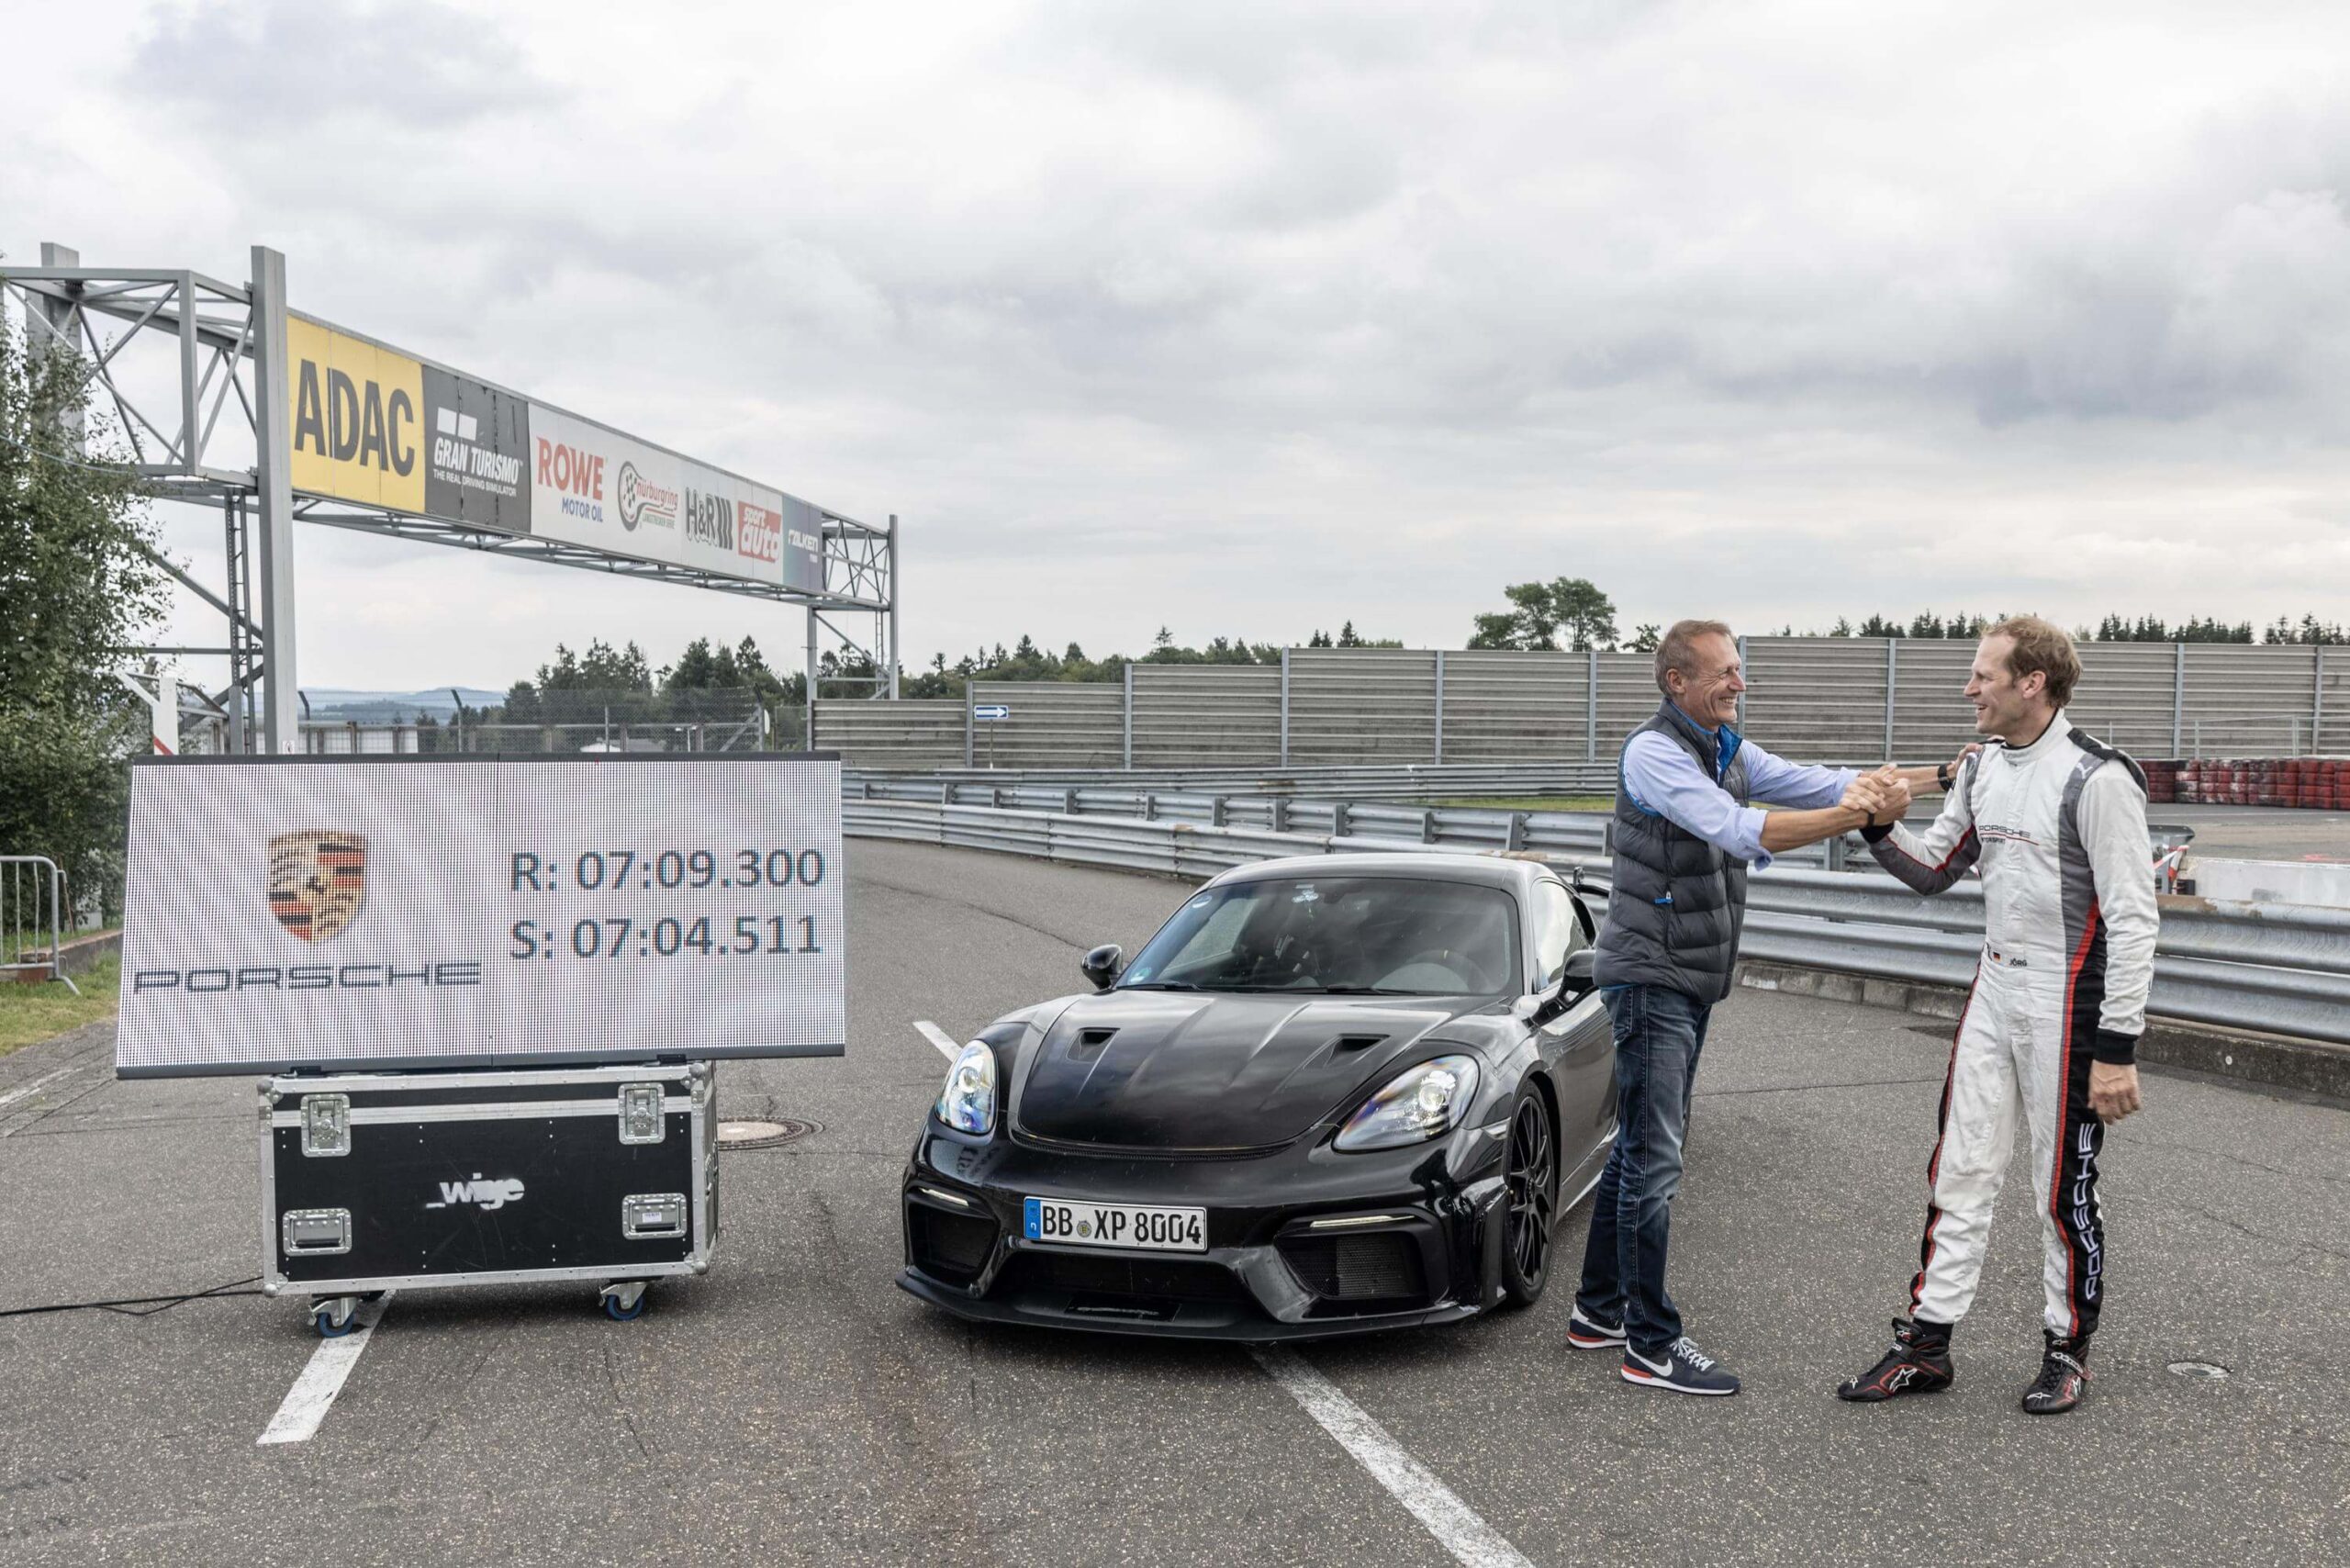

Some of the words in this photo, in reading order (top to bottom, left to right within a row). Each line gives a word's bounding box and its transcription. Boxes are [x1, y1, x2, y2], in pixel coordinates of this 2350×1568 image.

[295, 359, 415, 477] ADAC
[434, 437, 468, 472] GRAN
[471, 447, 519, 485] TURISMO
[537, 436, 603, 500] ROWE
[433, 468, 445, 480] THE
[446, 472, 461, 485] REAL
[463, 476, 485, 490] DRIVING
[486, 481, 517, 497] SIMULATOR
[562, 498, 590, 520] MOTOR
[591, 506, 603, 522] OIL
[686, 487, 716, 545] H&R
[744, 507, 766, 528] sport
[741, 525, 781, 560] auto
[1979, 824, 2031, 839] PORSCHE
[511, 852, 558, 891] R:
[576, 848, 825, 890] 07:09.300
[509, 922, 554, 960] S:
[571, 914, 822, 958] 07:04.511
[134, 961, 482, 994] PORSCHE
[2009, 958, 2027, 968] JÖRG
[1043, 1205, 1073, 1237] BB
[1094, 1209, 1126, 1240] XP
[1135, 1212, 1202, 1245] 8004
[2073, 1123, 2100, 1301] PORSCHE
